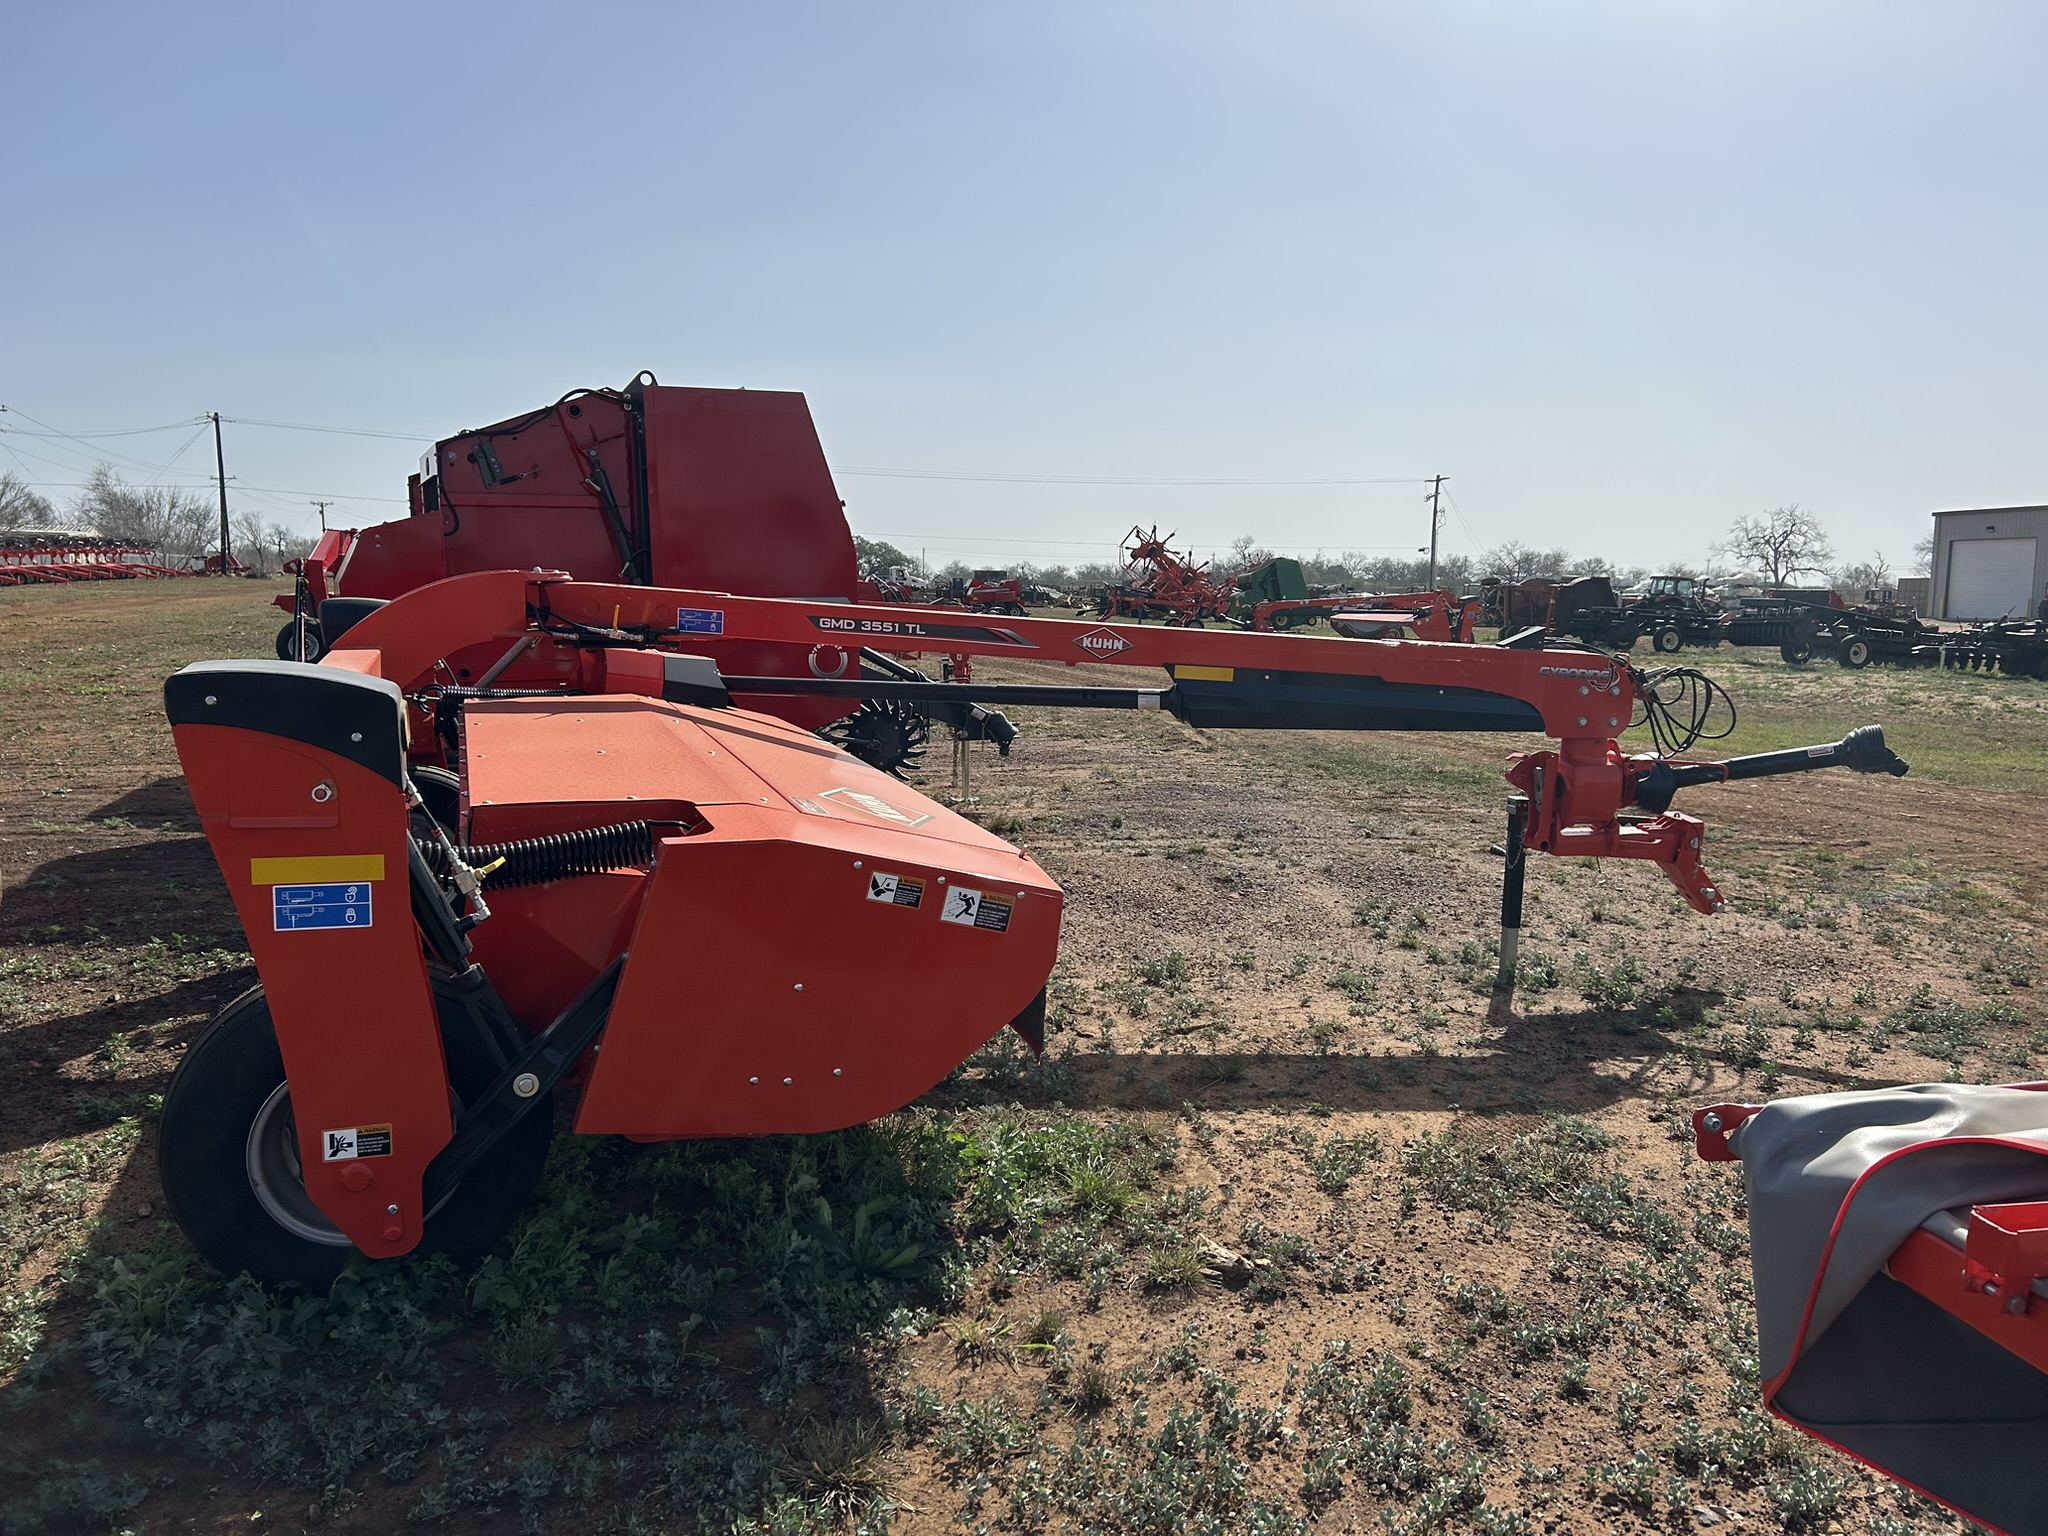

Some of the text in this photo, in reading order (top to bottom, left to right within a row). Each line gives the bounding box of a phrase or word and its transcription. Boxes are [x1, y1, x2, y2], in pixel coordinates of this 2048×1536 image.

[819, 617, 926, 635] GMD 3551 TL
[1082, 636, 1124, 650] KUHN
[1540, 666, 1610, 680] GYRODINE
